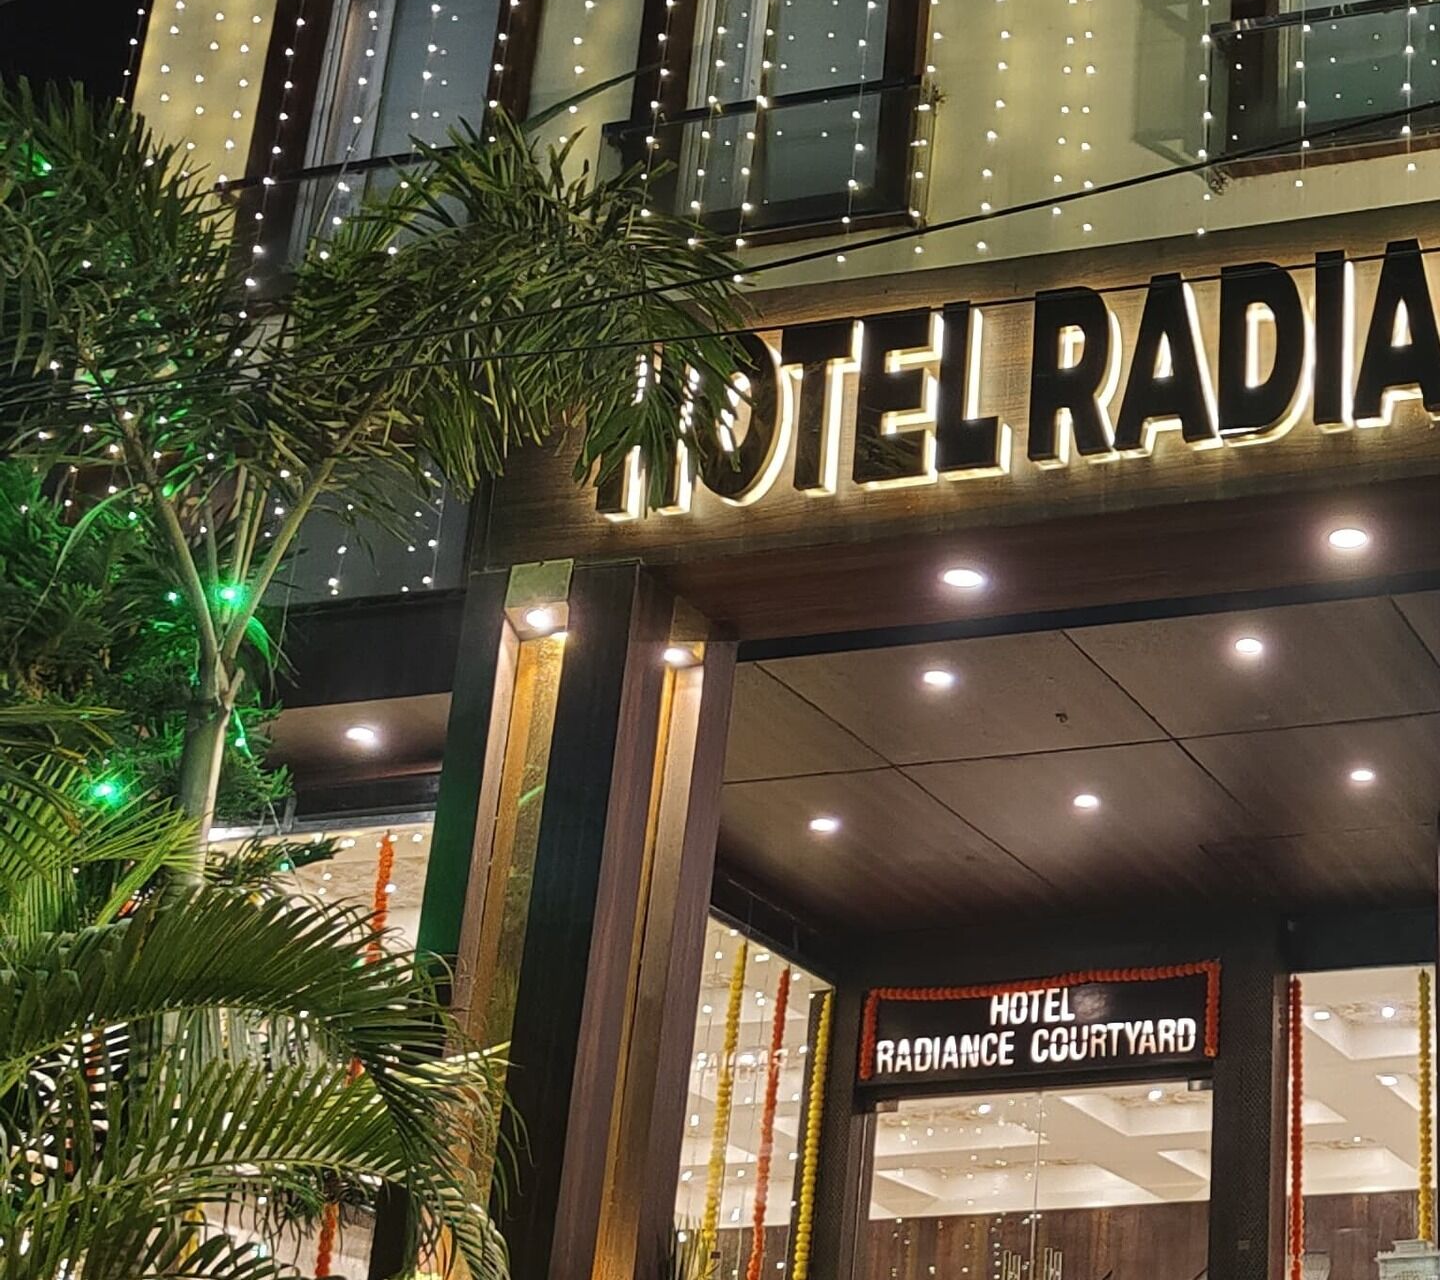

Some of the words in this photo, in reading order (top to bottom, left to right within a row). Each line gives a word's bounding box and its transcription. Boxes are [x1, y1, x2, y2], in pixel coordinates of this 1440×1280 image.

[989, 986, 1076, 1026] HOTEL
[875, 1030, 1016, 1074] RADIANCE
[1029, 1016, 1198, 1064] COURTYARD
